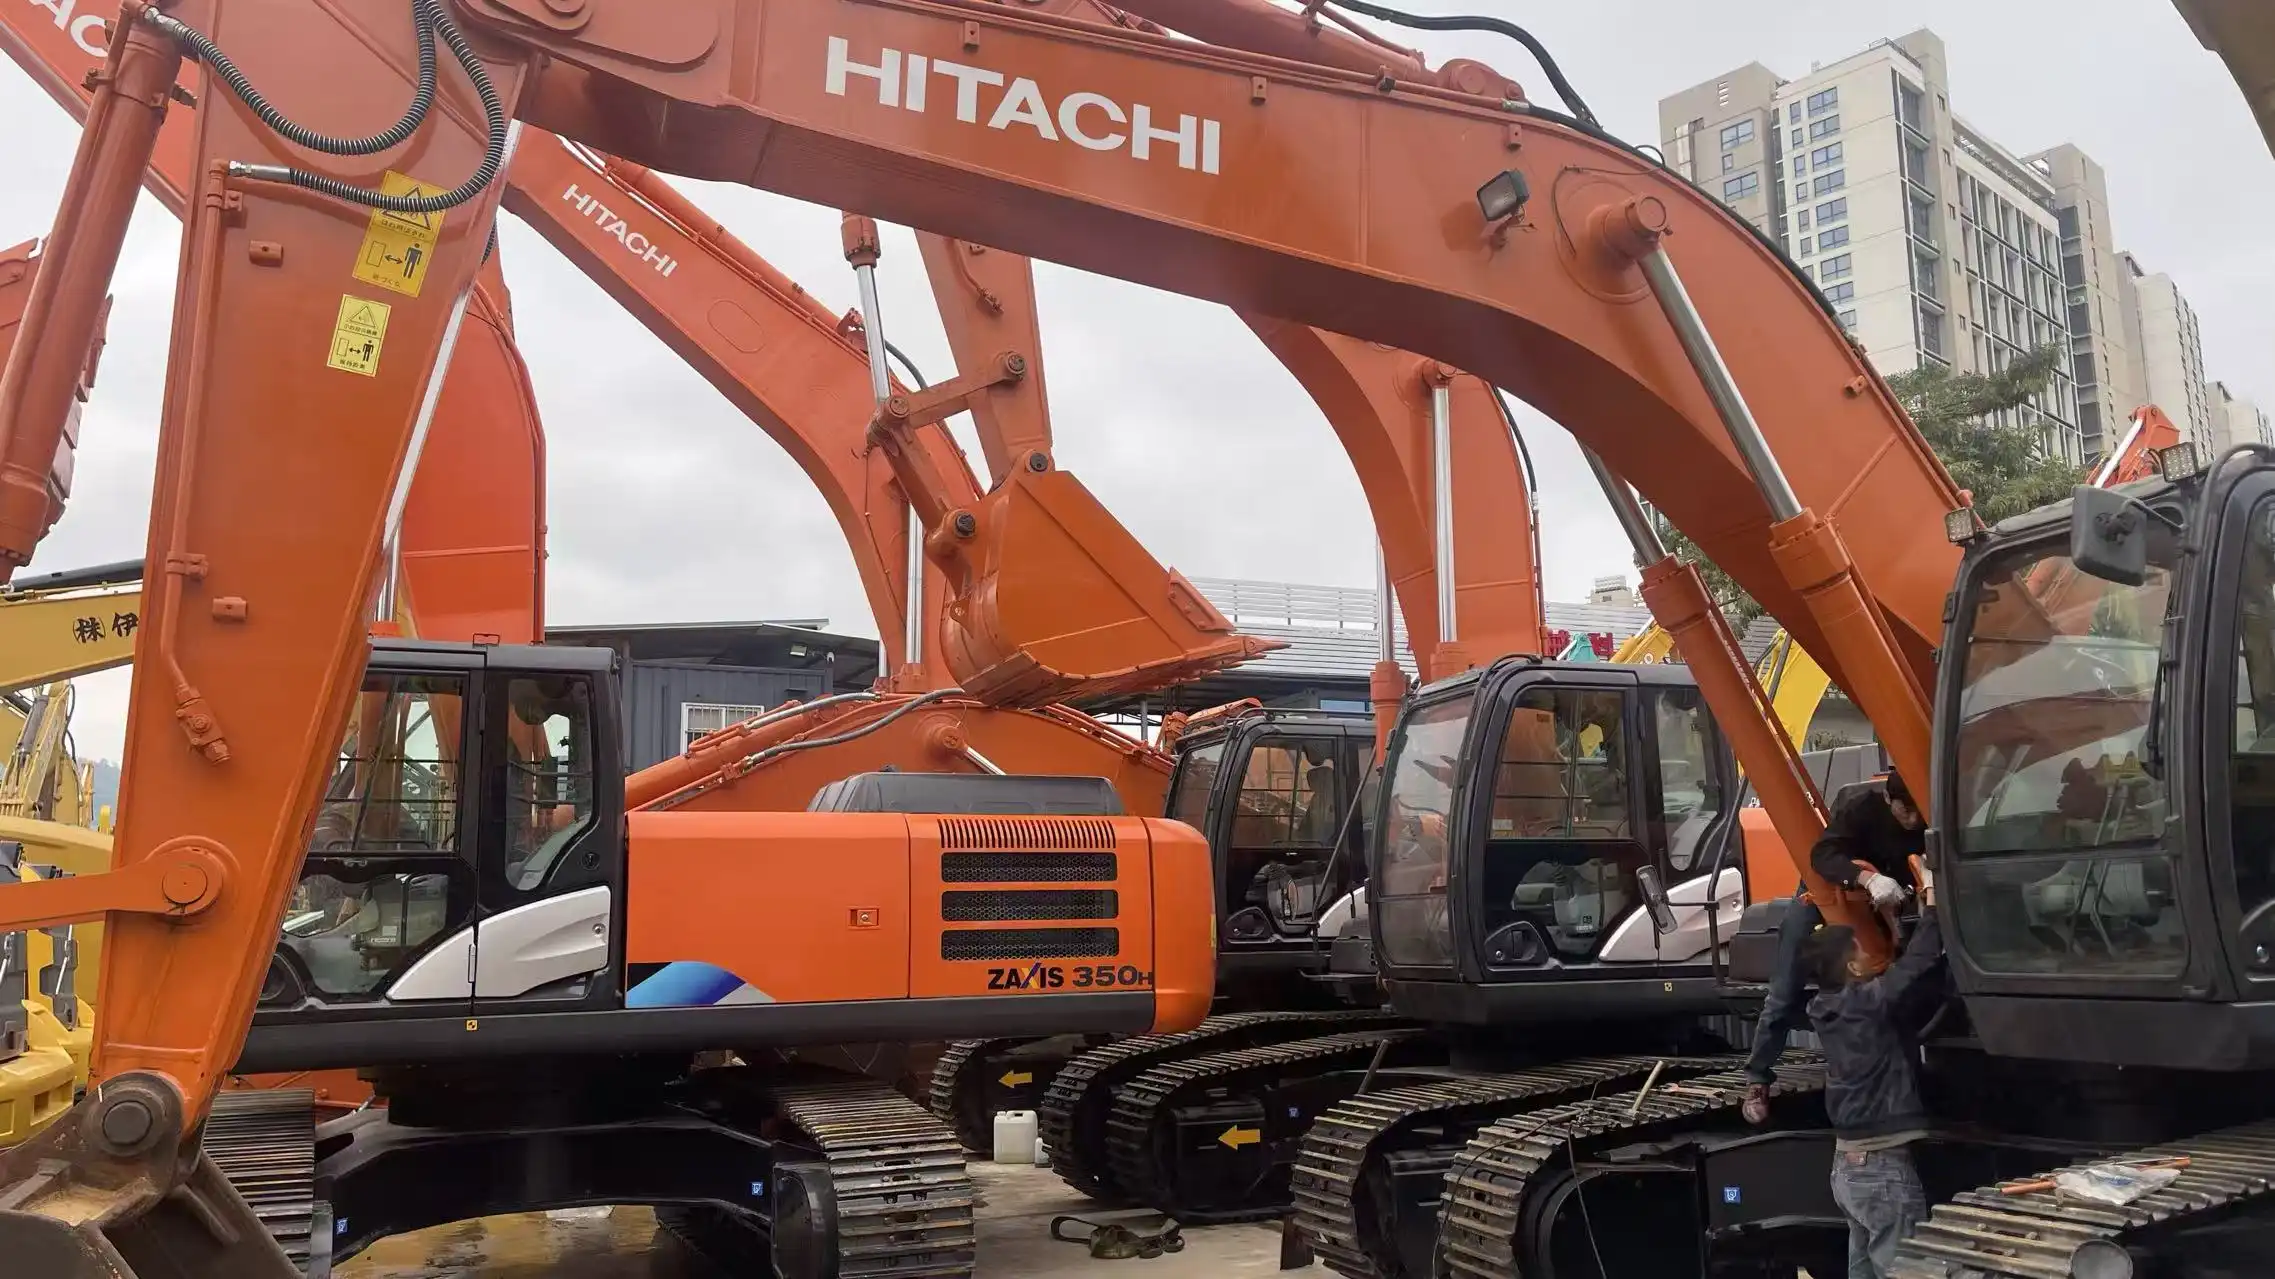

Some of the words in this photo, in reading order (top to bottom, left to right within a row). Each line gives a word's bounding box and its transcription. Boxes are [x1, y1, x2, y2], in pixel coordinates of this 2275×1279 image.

[825, 35, 1220, 175] HITACHI
[562, 183, 678, 277] HITACHI
[987, 962, 1065, 990] ZAXIS
